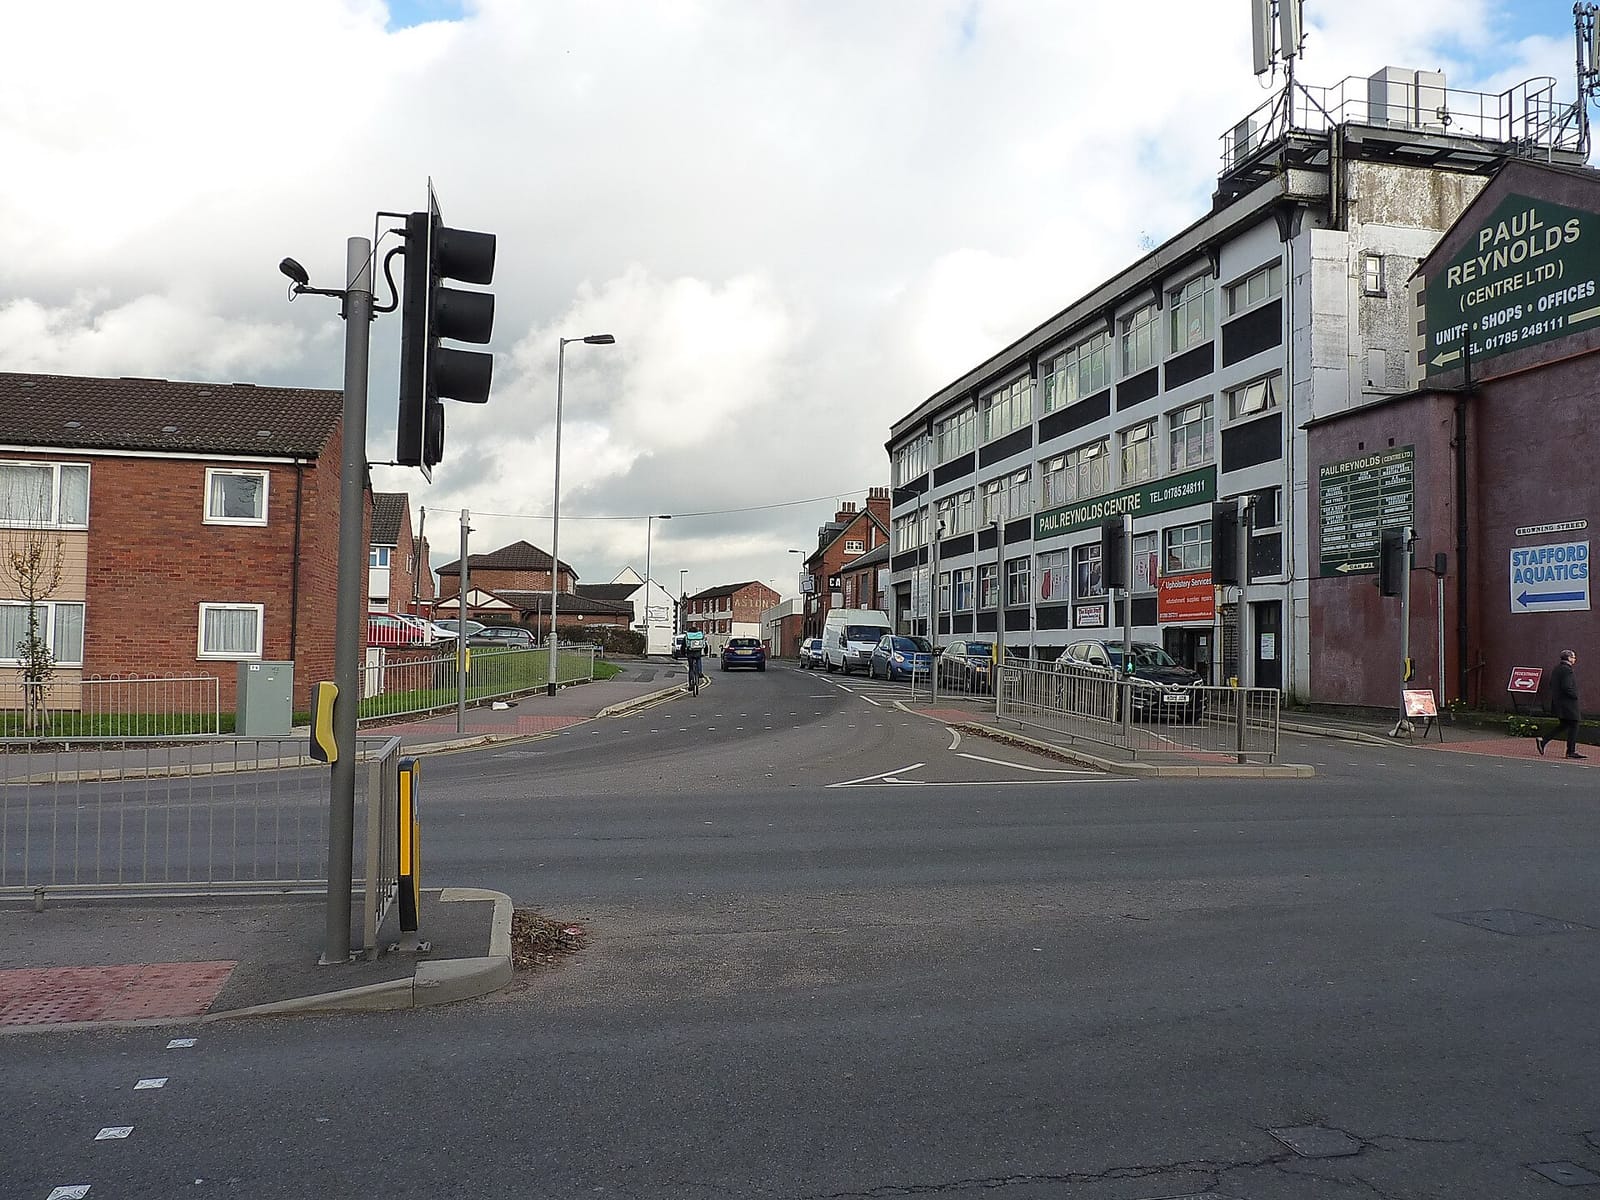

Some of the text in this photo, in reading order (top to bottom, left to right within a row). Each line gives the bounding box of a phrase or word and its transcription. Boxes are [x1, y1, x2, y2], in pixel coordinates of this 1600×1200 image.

[1479, 208, 1544, 251] PAUL
[1447, 218, 1580, 289] REYNOLDS
[1435, 280, 1596, 346] UNITS SHOPS OFFICES
[1485, 330, 1518, 350] 01785
[1521, 316, 1564, 340] 248111
[1320, 465, 1340, 477] PAUL
[1340, 455, 1380, 474] REYNOLDS
[1039, 479, 1205, 533] PAUL REYNOLDS CENTRE TEL. 01785 248111
[1556, 521, 1586, 530] STREET
[1512, 544, 1588, 567] STAFFORD
[1165, 577, 1212, 590] Upholstery Services
[1513, 562, 1588, 585] AQUATICS
